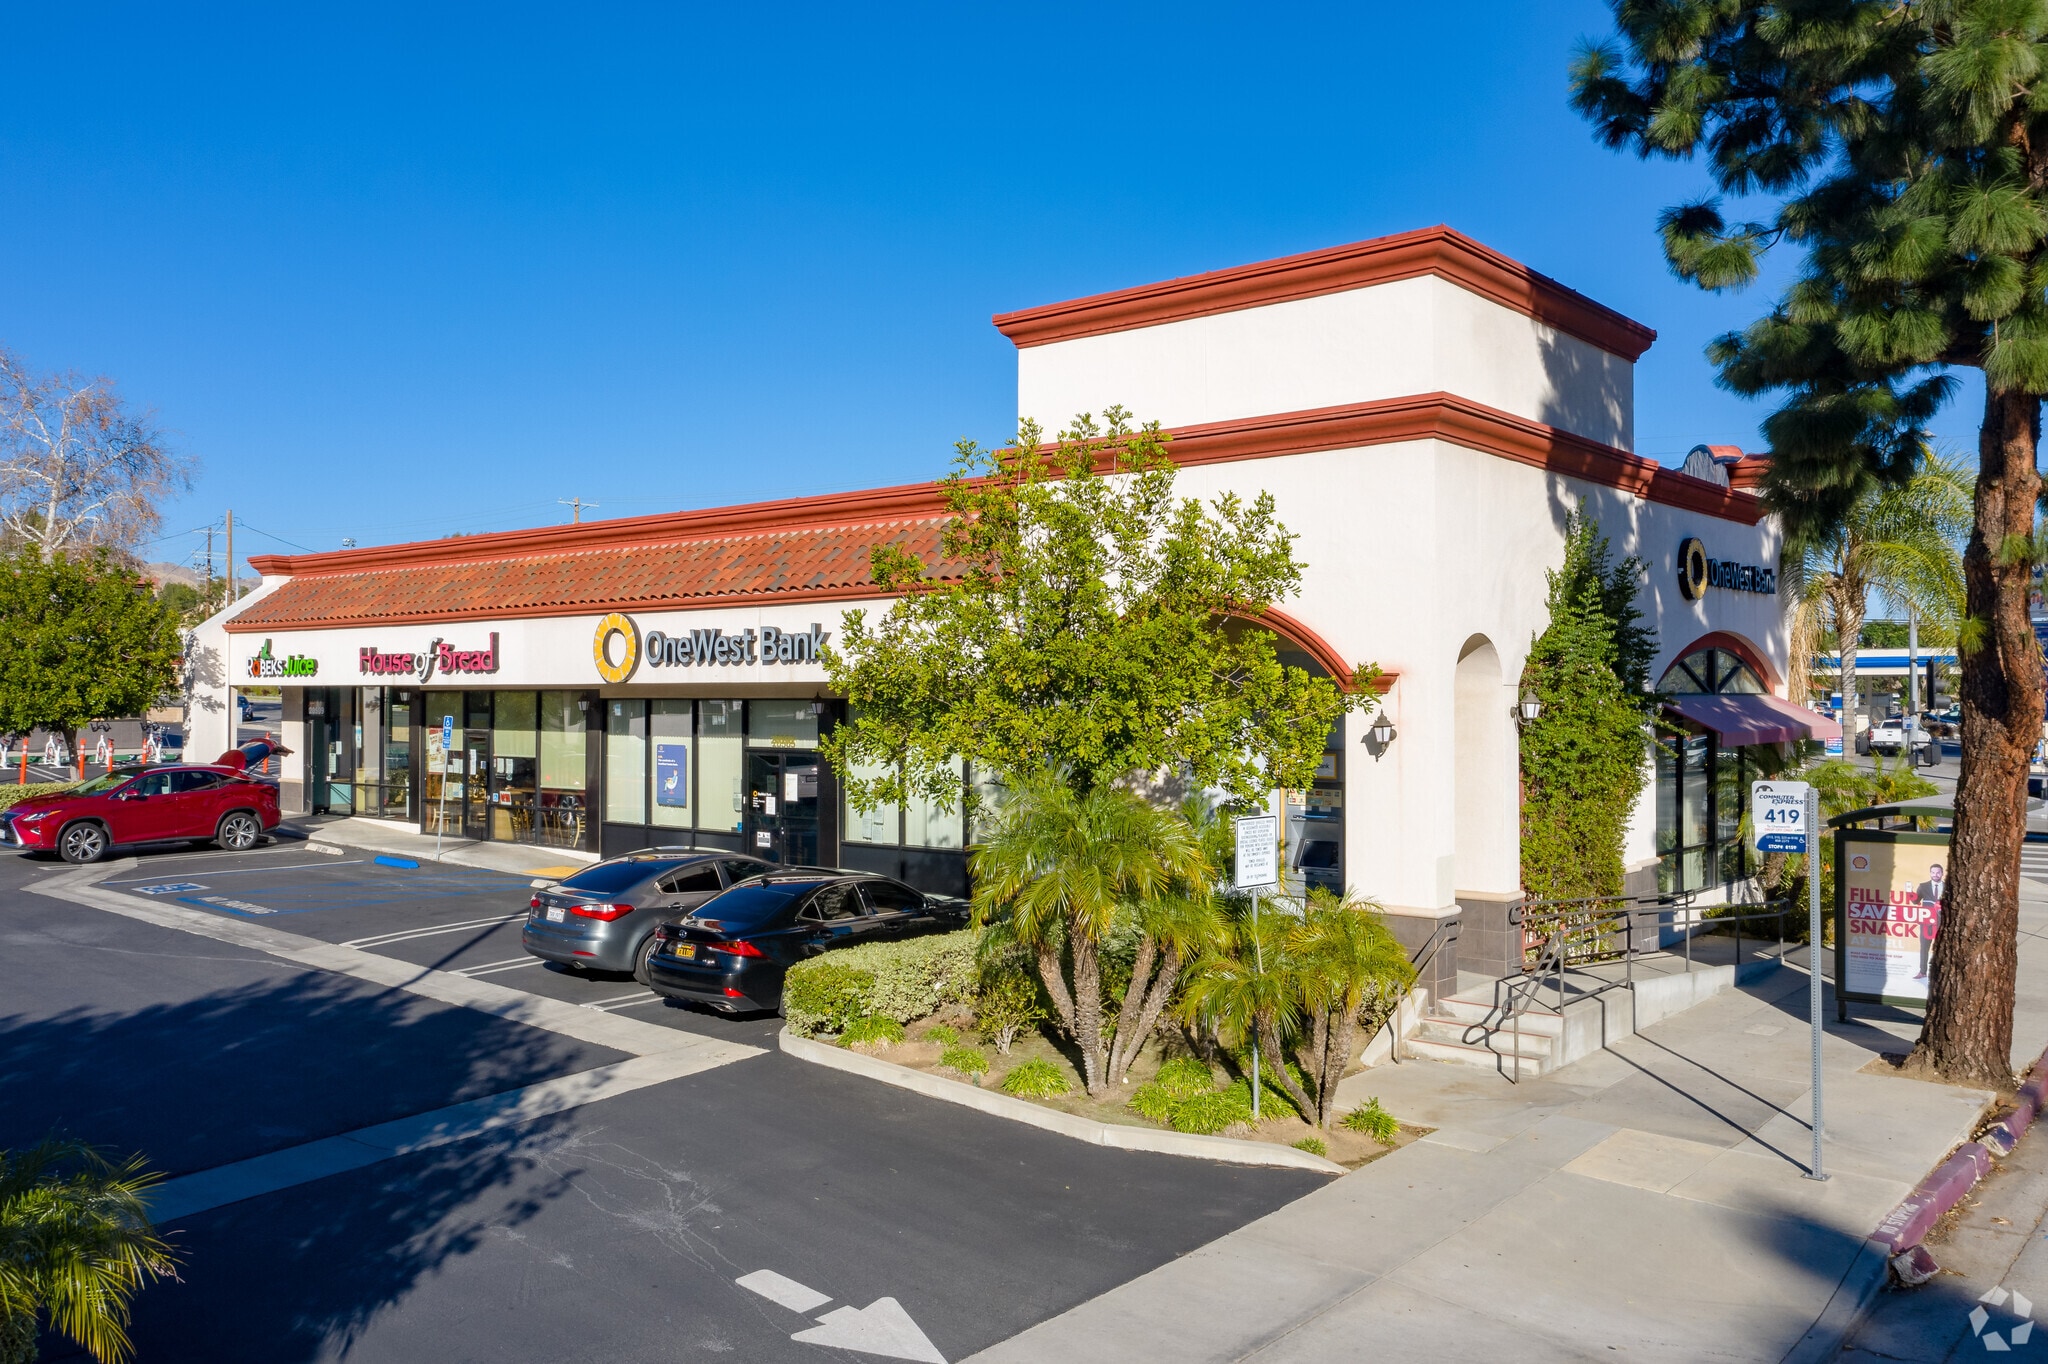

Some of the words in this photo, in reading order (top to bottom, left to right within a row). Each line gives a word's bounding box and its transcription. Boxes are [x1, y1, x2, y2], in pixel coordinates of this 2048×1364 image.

[1710, 558, 1753, 591] OneWest
[644, 628, 755, 666] OneWest
[760, 623, 829, 664] Bank
[283, 654, 315, 676] Juice
[359, 646, 412, 673] House
[413, 637, 442, 684] of
[438, 632, 498, 674] Bread
[1765, 809, 1799, 823] 419
[1850, 888, 1884, 903] FILL
[1890, 890, 1921, 905] UP.
[1850, 903, 1897, 921] SAVE
[1903, 907, 1936, 924] UP.
[1850, 920, 1918, 938] SNACK
[1923, 924, 1939, 940] U
[1851, 935, 1866, 946] AT
